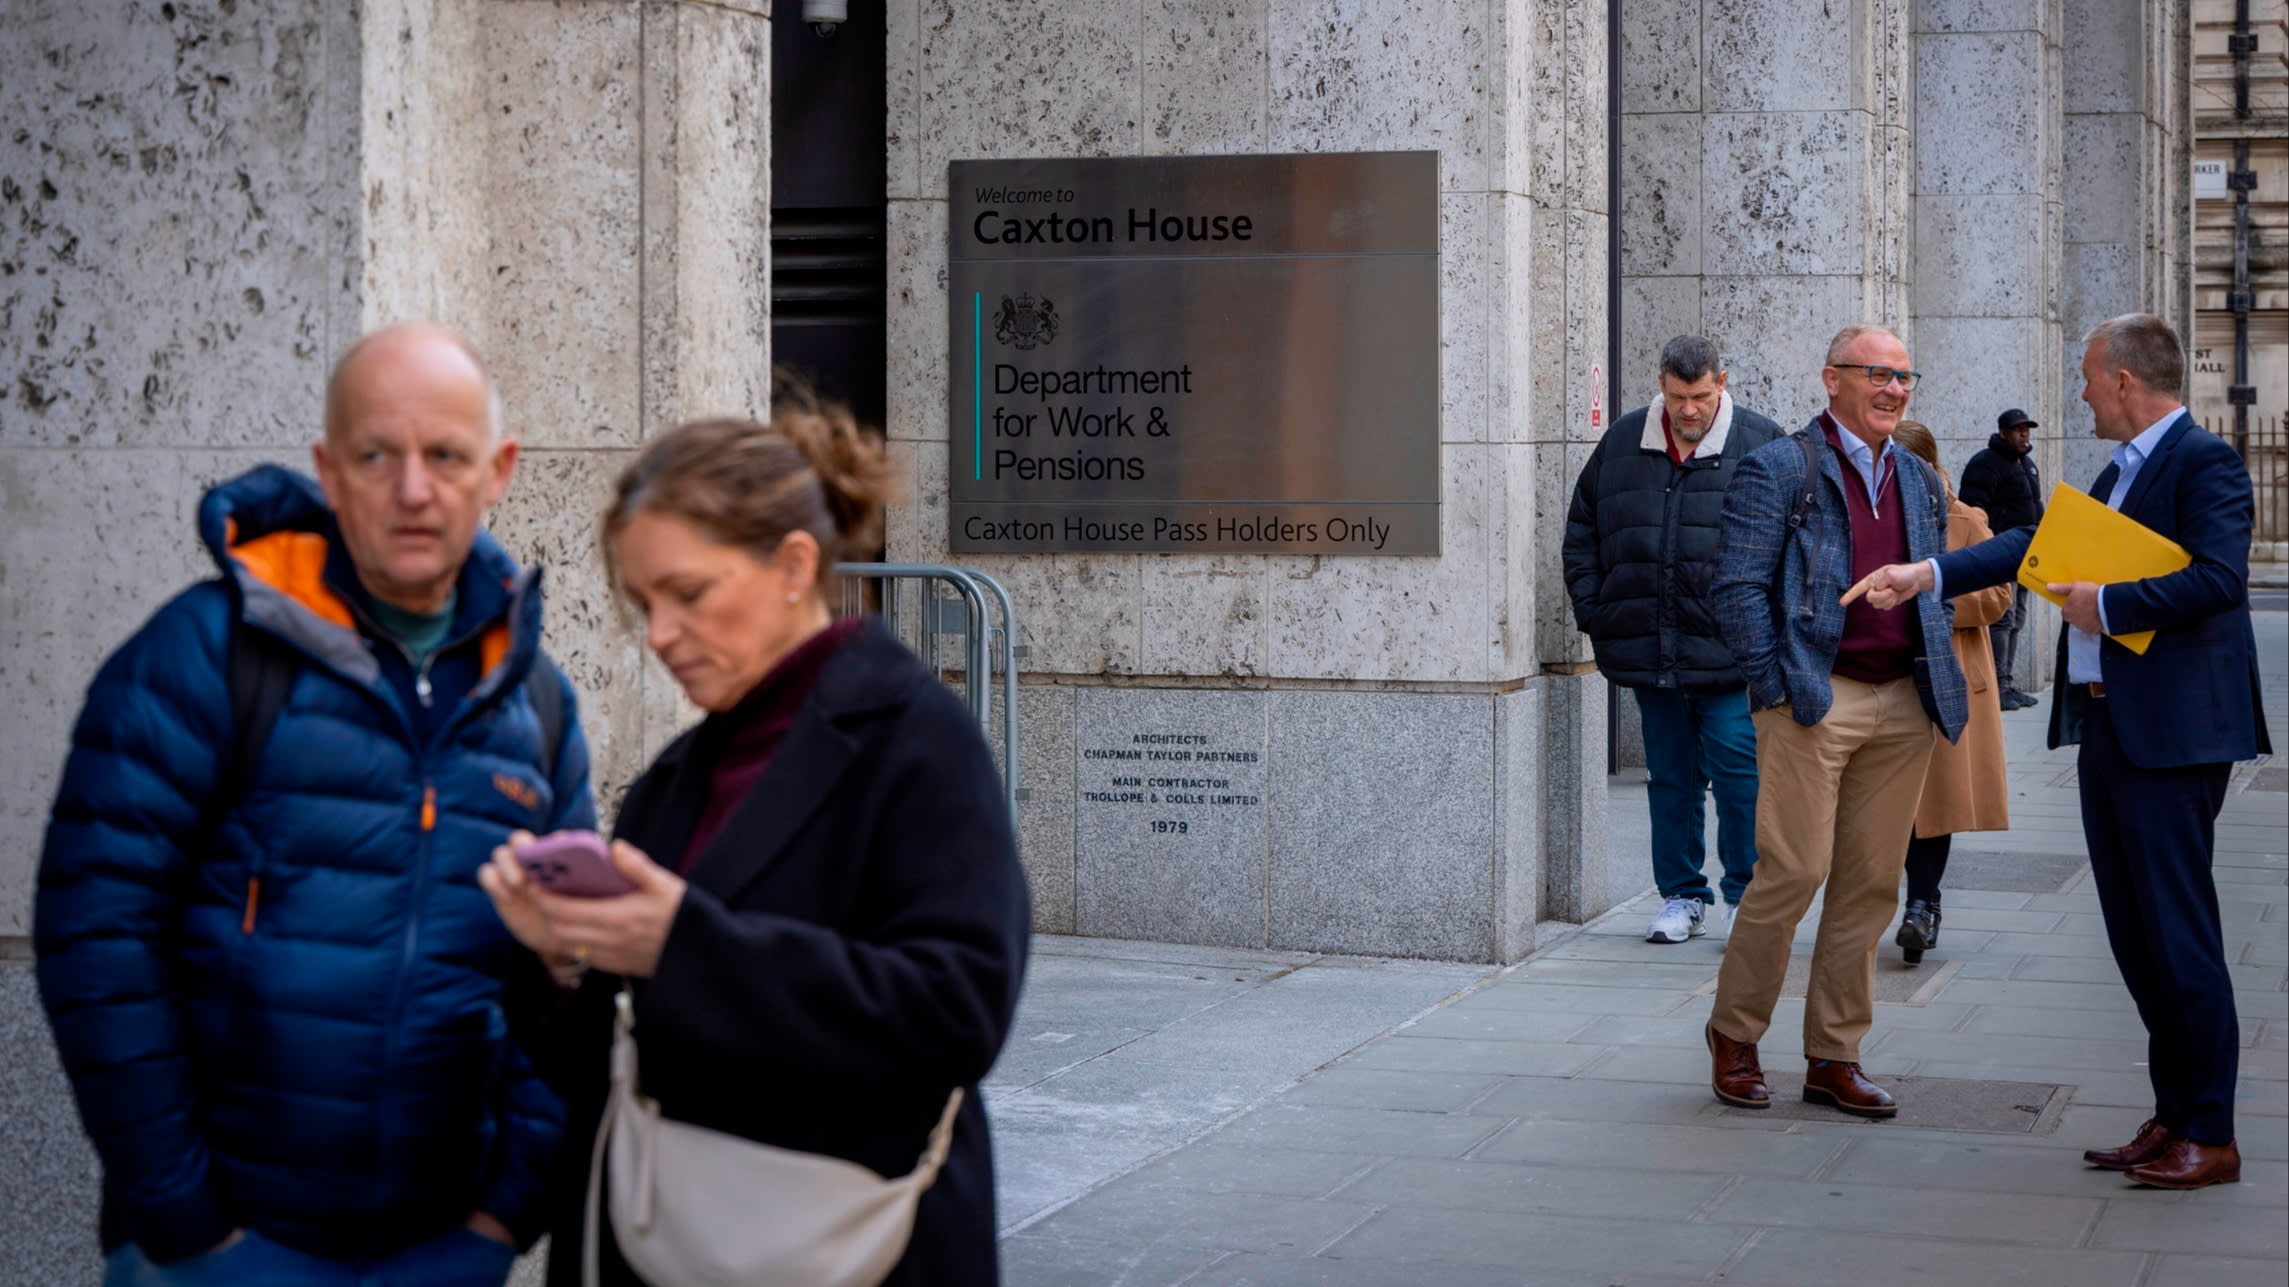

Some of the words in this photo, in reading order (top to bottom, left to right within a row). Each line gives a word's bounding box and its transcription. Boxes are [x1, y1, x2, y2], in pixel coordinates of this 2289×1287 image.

[975, 186, 1053, 204] Welcome
[1057, 188, 1075, 203] to
[973, 210, 1114, 245] Caxton
[1127, 208, 1253, 242] House
[993, 363, 1193, 403] Department
[992, 406, 1038, 438] for
[1048, 406, 1136, 438] Work
[1145, 406, 1171, 438] &
[993, 450, 1145, 481] Pensions
[964, 516, 1054, 542] Caxton
[1063, 517, 1144, 541] House
[1153, 517, 1208, 542] Pass
[1216, 516, 1319, 542] Holders
[1326, 516, 1391, 550] Only
[1132, 734, 1207, 745] ARCHITECTS
[1083, 749, 1142, 761] CHAPMAN
[1147, 749, 1192, 761] TAYLOR
[1196, 750, 1258, 763] PARTNERS
[1112, 777, 1142, 787] MAIN
[1148, 777, 1229, 789] CONTRACTOR
[1083, 791, 1145, 803] TROLLOPE
[1150, 793, 1158, 804] &
[1166, 794, 1205, 805] COLLS
[1210, 795, 1258, 806] LIMITED
[1150, 820, 1188, 834] 1979
